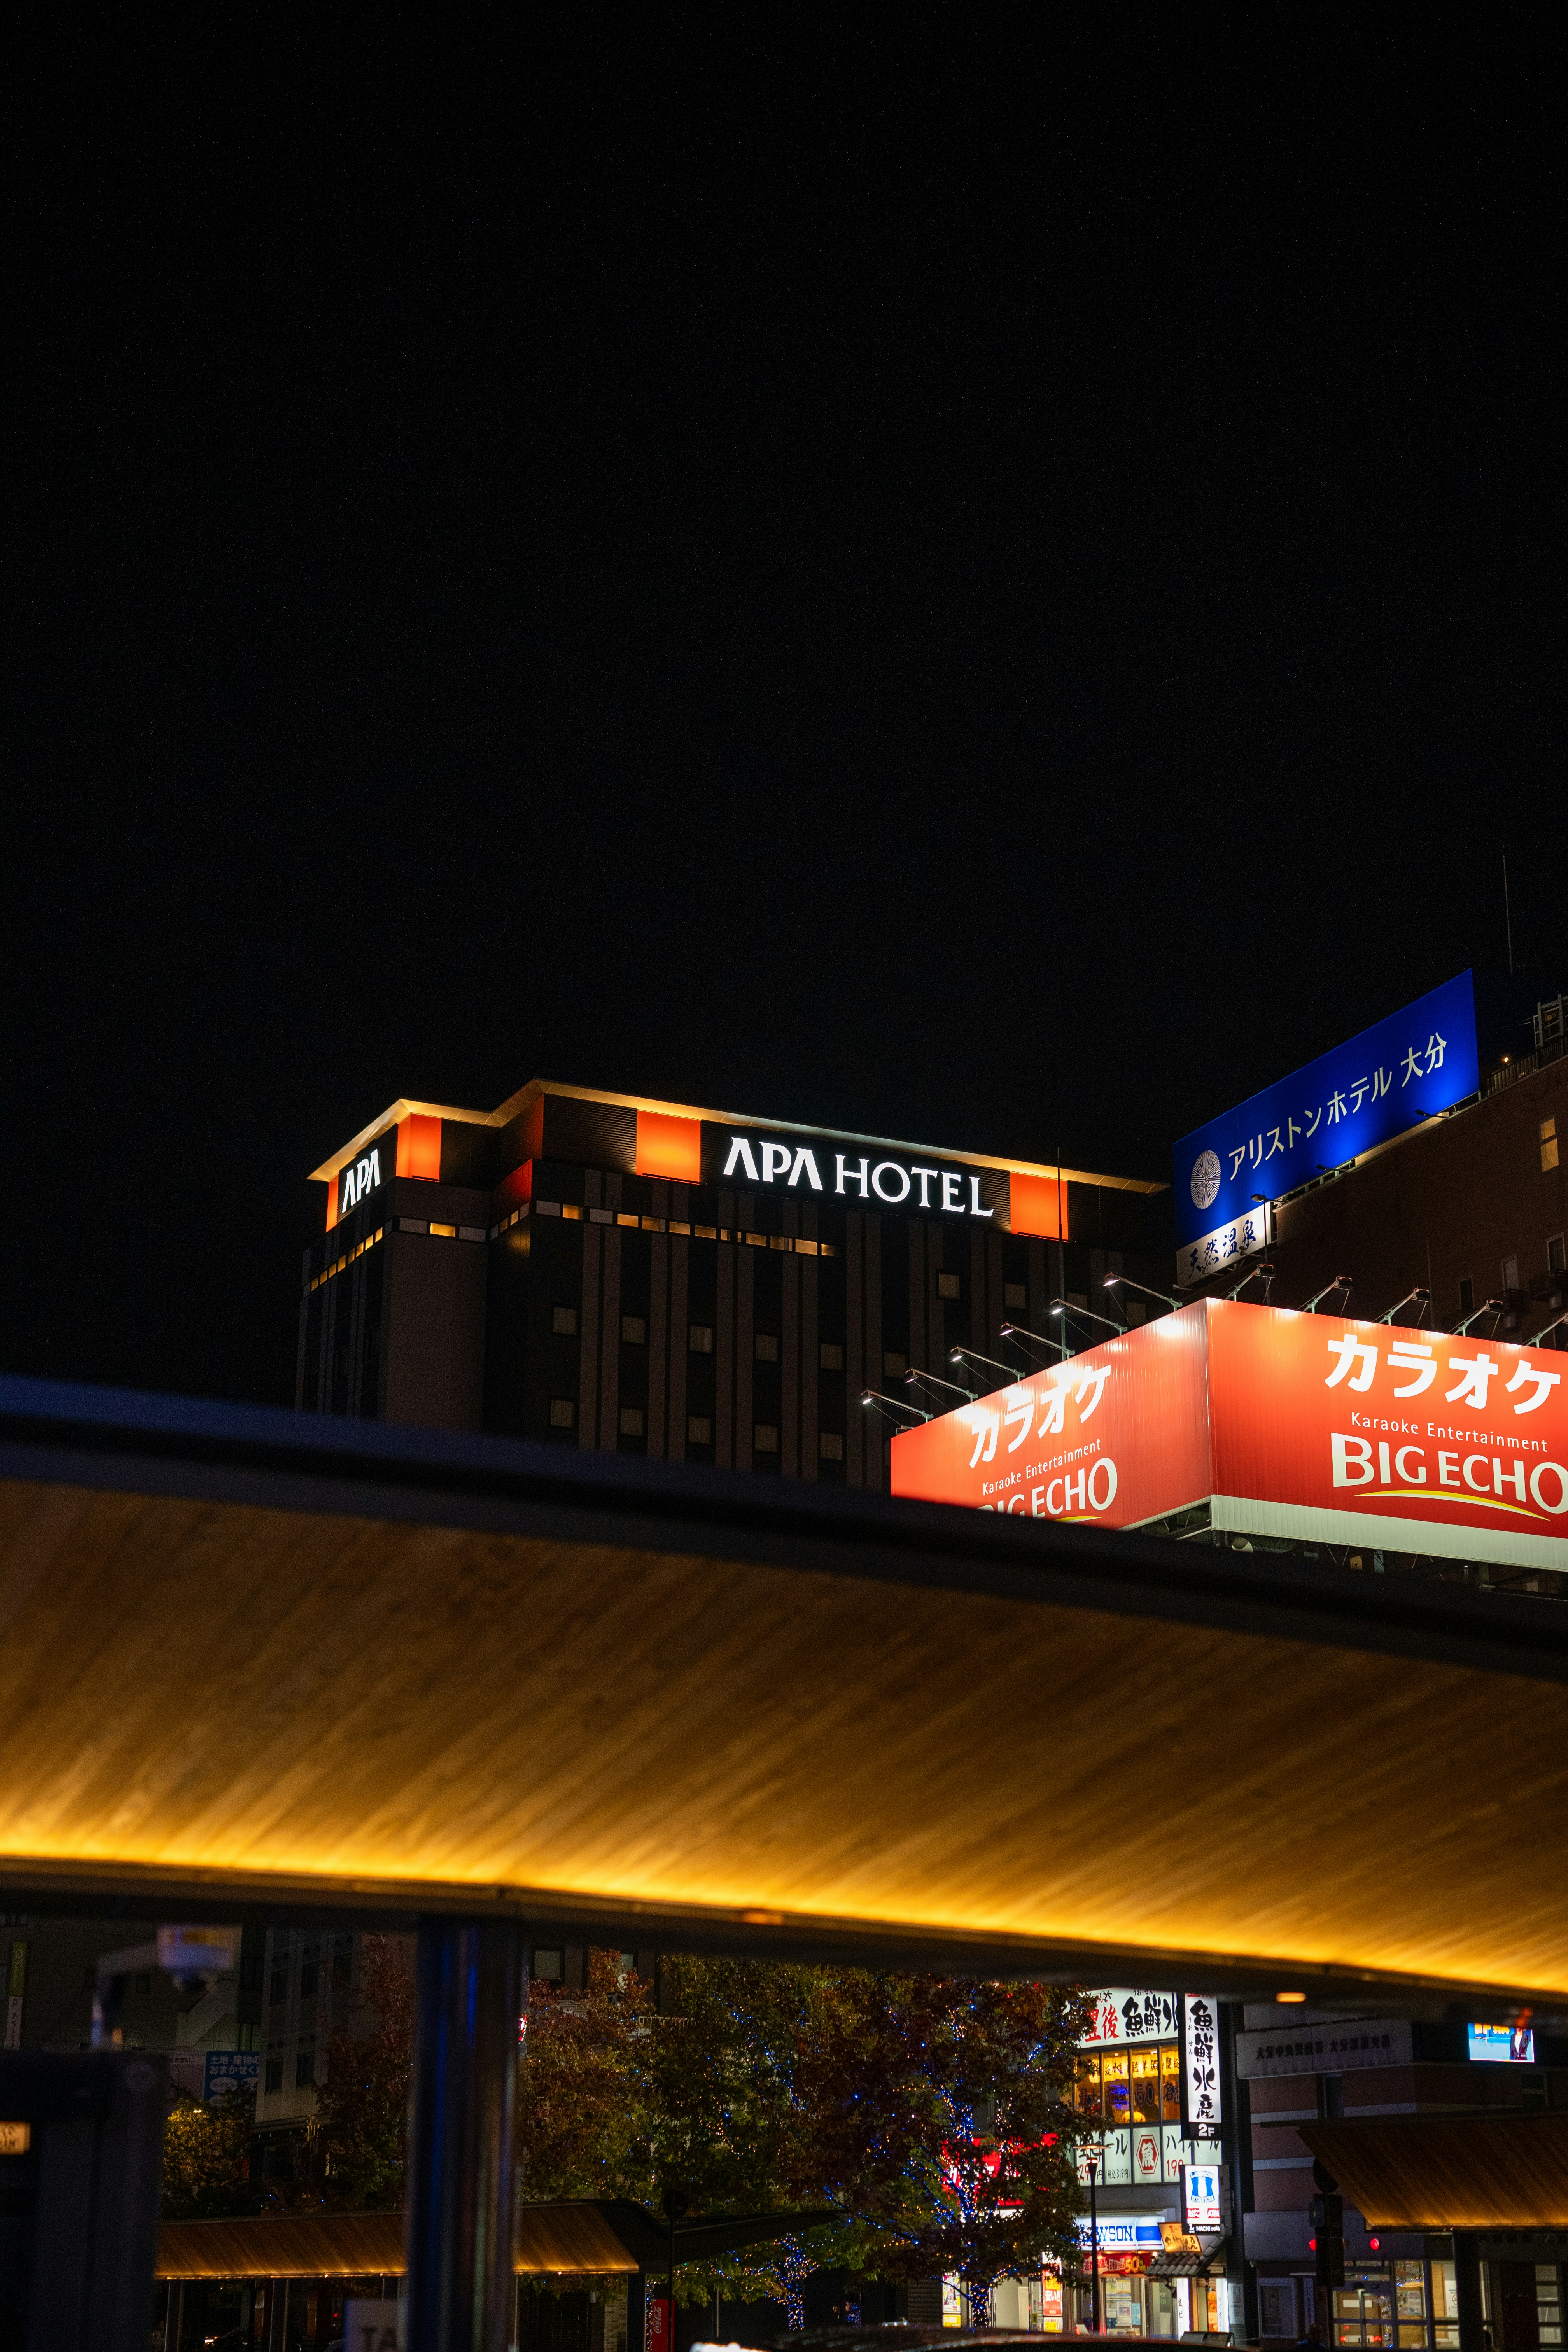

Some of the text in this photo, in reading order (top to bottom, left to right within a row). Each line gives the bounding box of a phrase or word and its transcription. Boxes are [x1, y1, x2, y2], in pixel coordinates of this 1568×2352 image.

[1228, 1032, 1447, 1181] アリストンホテル 大分
[342, 1148, 381, 1214] APA
[723, 1136, 994, 1217] APA HOTEL
[1188, 1219, 1256, 1279] 天然温泉
[1324, 1333, 1561, 1415] カラオケ
[969, 1364, 1111, 1469] カラオケ
[1351, 1412, 1548, 1452] Karaoke Entertainment
[983, 1438, 1101, 1496] Karaoke Entertainment
[1032, 1457, 1118, 1519] ECHO
[1330, 1432, 1568, 1514] BIG ECHO
[1189, 1999, 1217, 2120] 魚鮮水産
[1198, 2123, 1215, 2137] 2F
